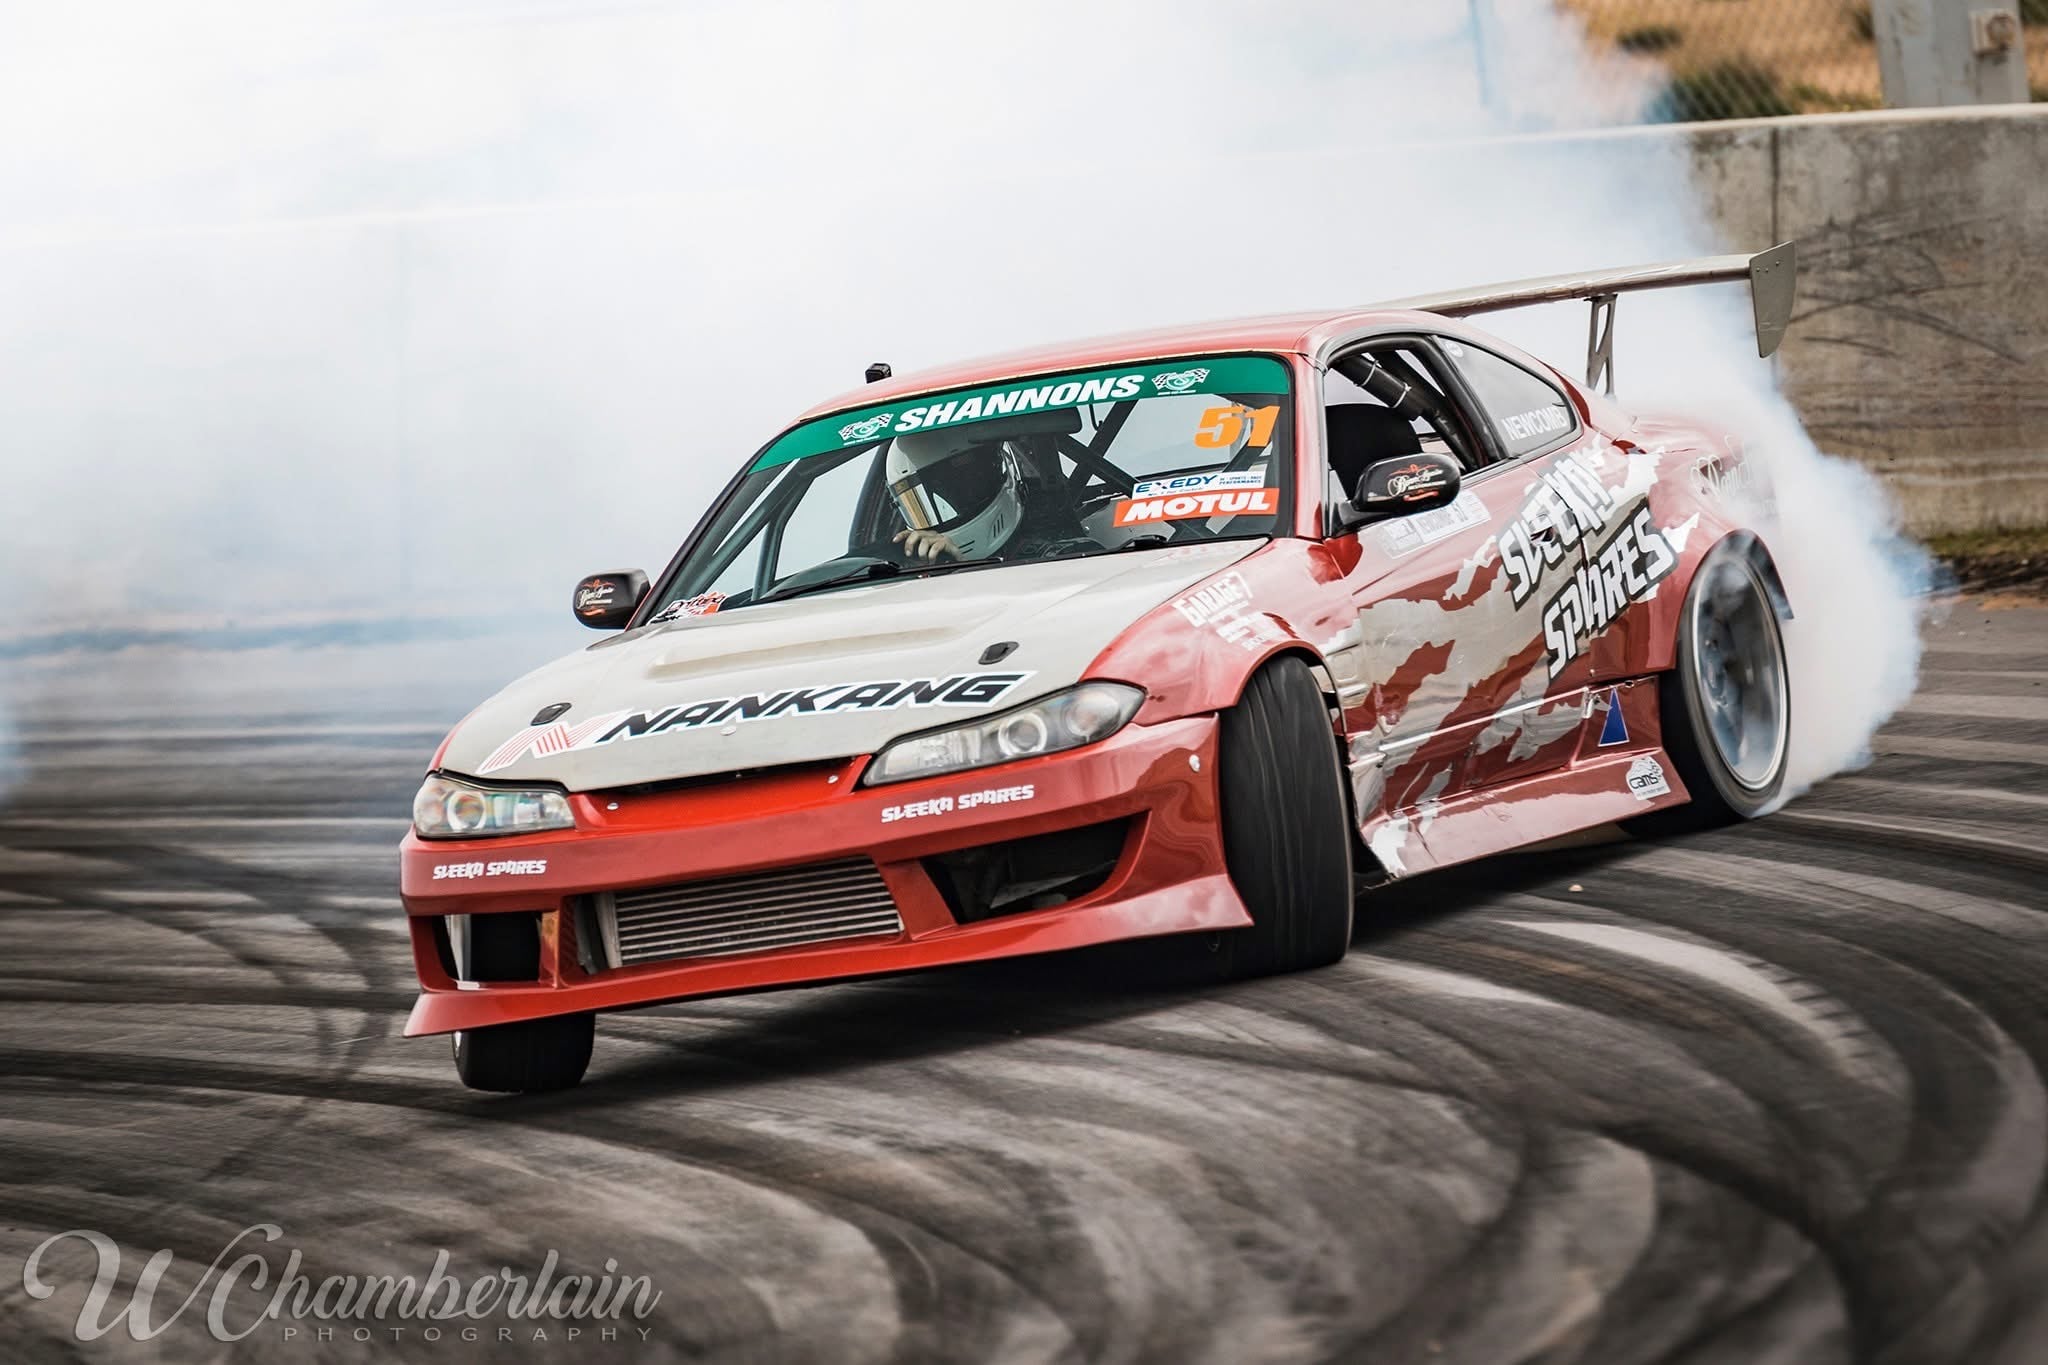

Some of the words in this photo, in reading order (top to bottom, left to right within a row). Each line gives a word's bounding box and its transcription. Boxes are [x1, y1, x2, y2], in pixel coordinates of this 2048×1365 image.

[894, 374, 1146, 432] SHANNONS
[1194, 405, 1280, 450] 51
[1135, 474, 1218, 493] EXEDY
[1122, 491, 1272, 522] MOTUL
[1543, 507, 1674, 680] SPARES
[595, 673, 1028, 744] NANKANG
[881, 796, 954, 825] SLEEKA
[957, 784, 1035, 810] SPARES
[432, 861, 485, 880] SLEEKA
[485, 859, 547, 877] SPARES
